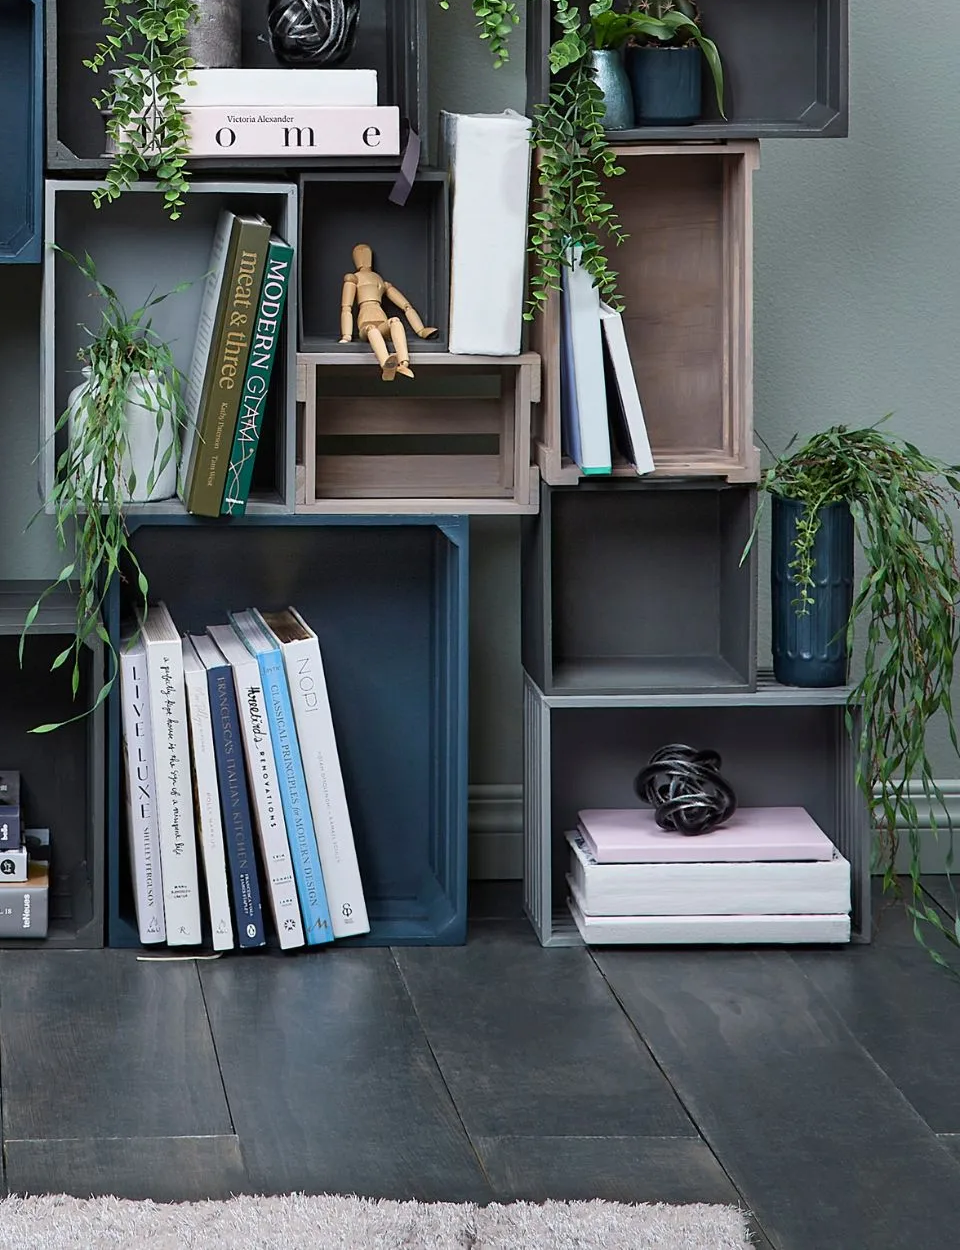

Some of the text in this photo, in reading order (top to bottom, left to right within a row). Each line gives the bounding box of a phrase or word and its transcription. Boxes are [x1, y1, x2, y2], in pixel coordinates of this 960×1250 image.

[227, 114, 294, 123] Victoria Alexander
[219, 251, 257, 390] meat & three
[237, 259, 288, 442] MODERN GLAM
[297, 658, 318, 712] NOPI
[133, 666, 150, 818] LIVE LUXE
[167, 717, 179, 739] house
[170, 754, 180, 768] the
[217, 677, 248, 868] FRANCESCA'S ITALIAN KITCHEN
[260, 751, 277, 827] RENOVATIONS
[271, 685, 288, 742] CLASSICAL
[281, 745, 299, 804] PRINCIPLES
[295, 818, 311, 864] MODERN
[304, 866, 319, 906] DESIGN
[173, 842, 184, 855] life
[23, 894, 31, 929] teNeues
[145, 863, 154, 907] FERGUSON
